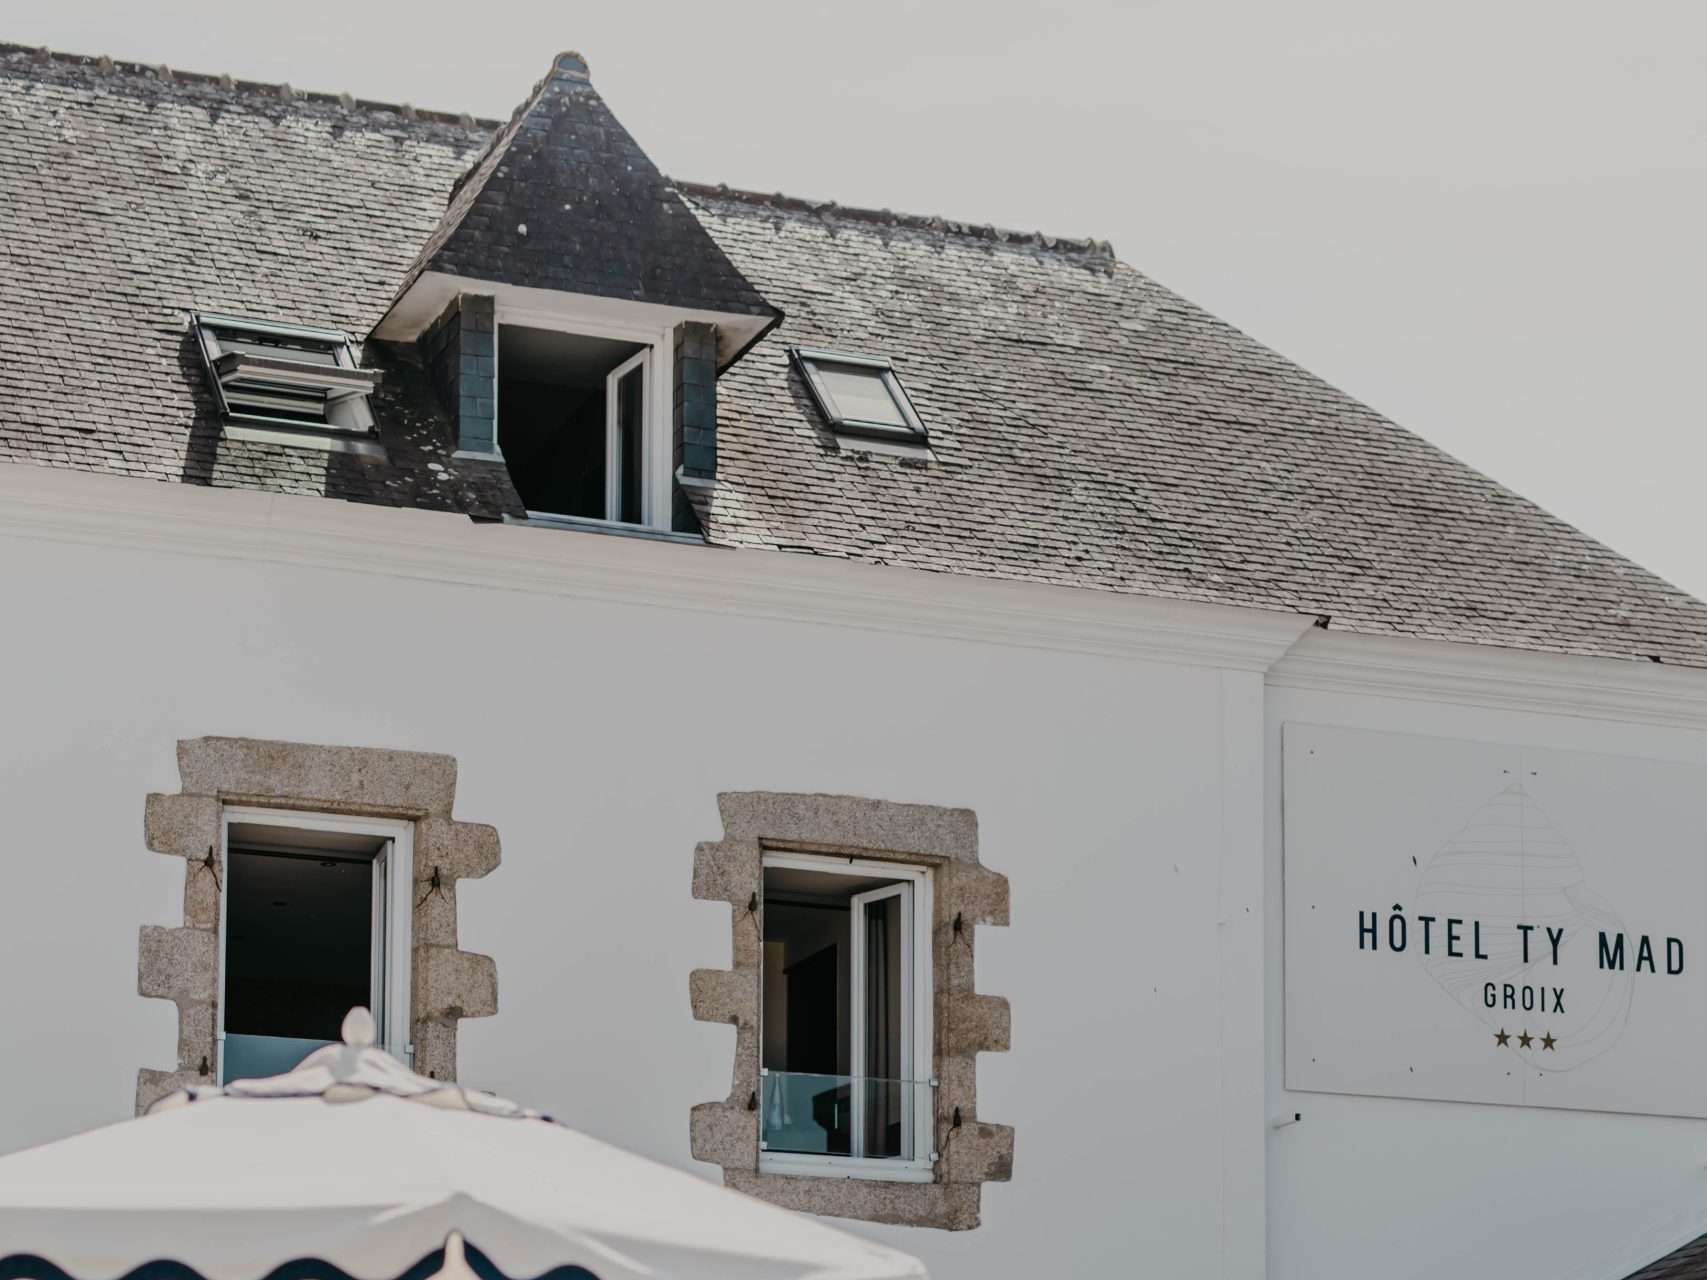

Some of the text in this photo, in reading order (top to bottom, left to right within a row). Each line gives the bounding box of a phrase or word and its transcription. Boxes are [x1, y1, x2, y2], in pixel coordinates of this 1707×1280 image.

[1358, 903, 1684, 976] HÔTEL TY MAD
[1483, 982, 1565, 1014] GROIX
